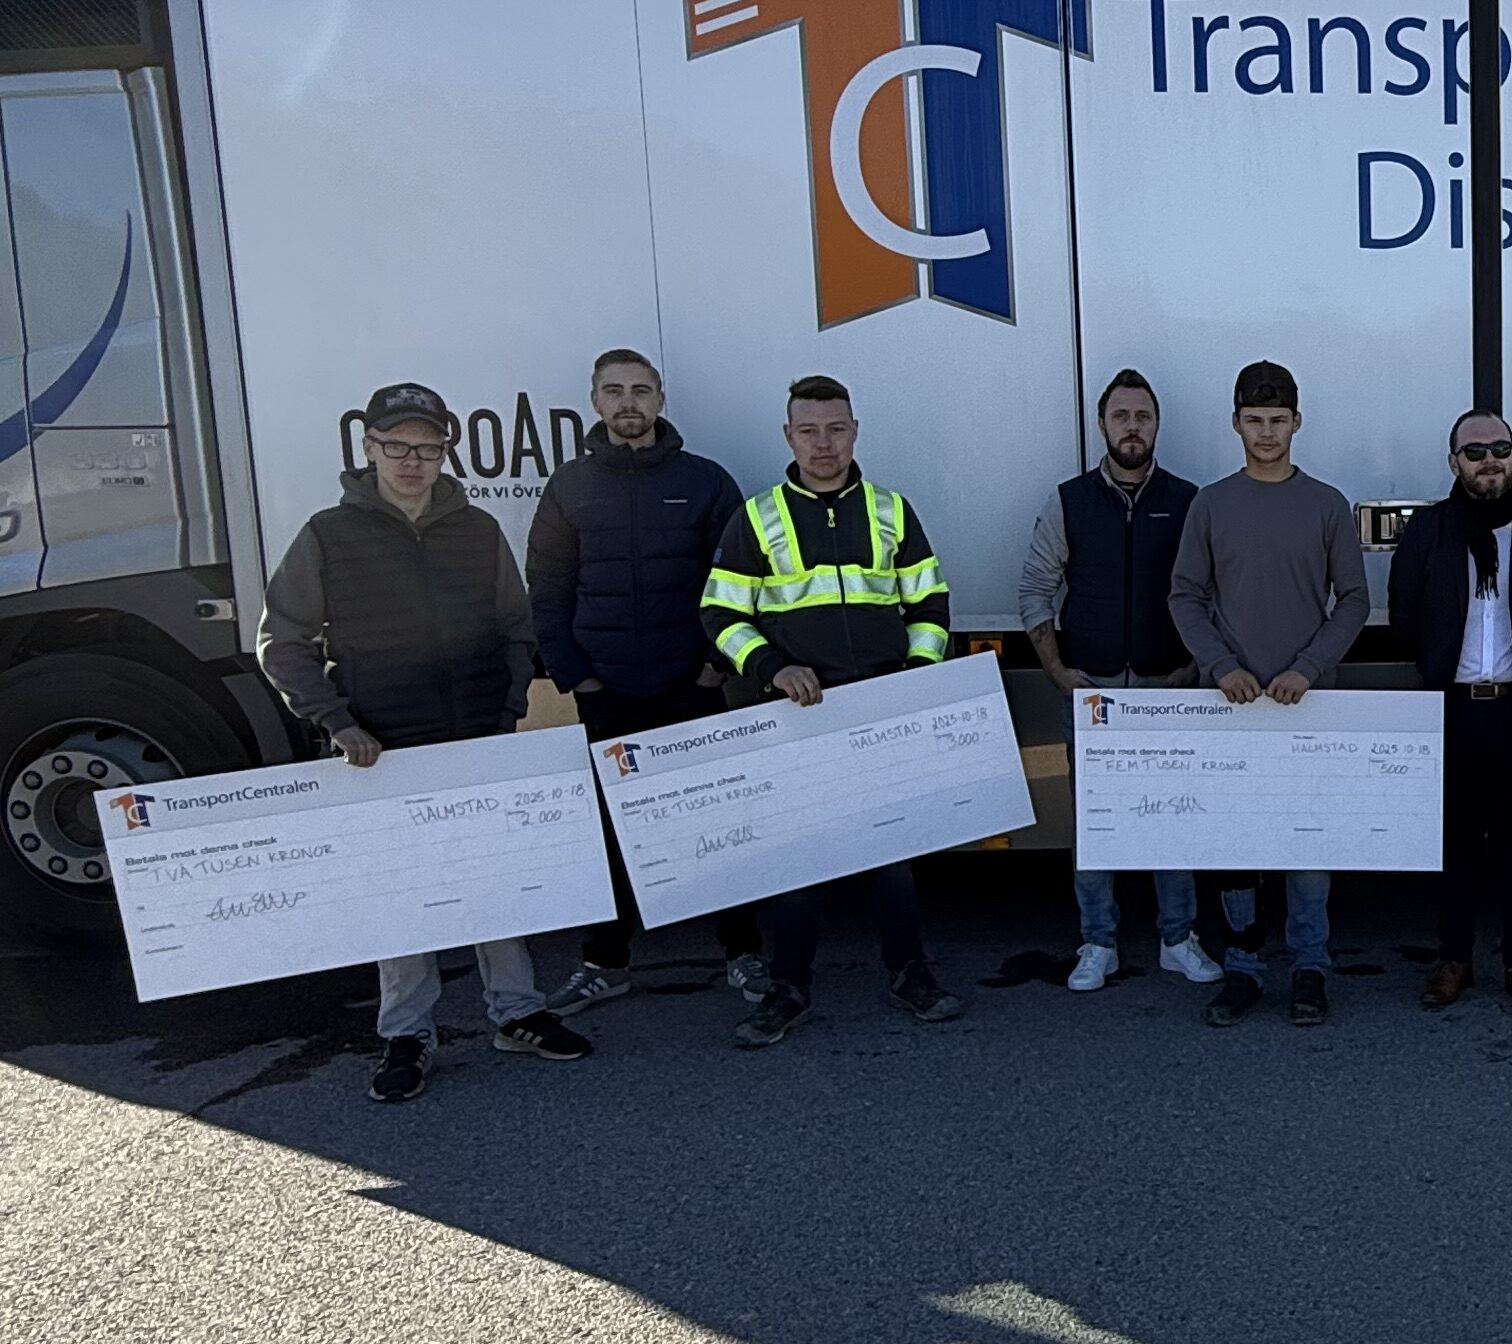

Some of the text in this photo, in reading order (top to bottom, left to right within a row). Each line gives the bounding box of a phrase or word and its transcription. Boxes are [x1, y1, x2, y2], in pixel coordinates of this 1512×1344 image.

[494, 487, 508, 499] VI
[512, 484, 543, 498] ÖVE
[1119, 703, 1233, 717] TransportCentralen
[647, 718, 777, 758] TransportCentralen
[849, 722, 922, 752] HALMSTAD
[1291, 743, 1358, 753] HALMSTAD
[1106, 759, 1138, 772] FEM
[163, 779, 320, 812] TransportCentralen
[410, 797, 500, 826] HALMSTAD
[642, 805, 670, 823] TRE
[196, 855, 260, 875] TUSEN
[268, 844, 337, 863] KRONOR
